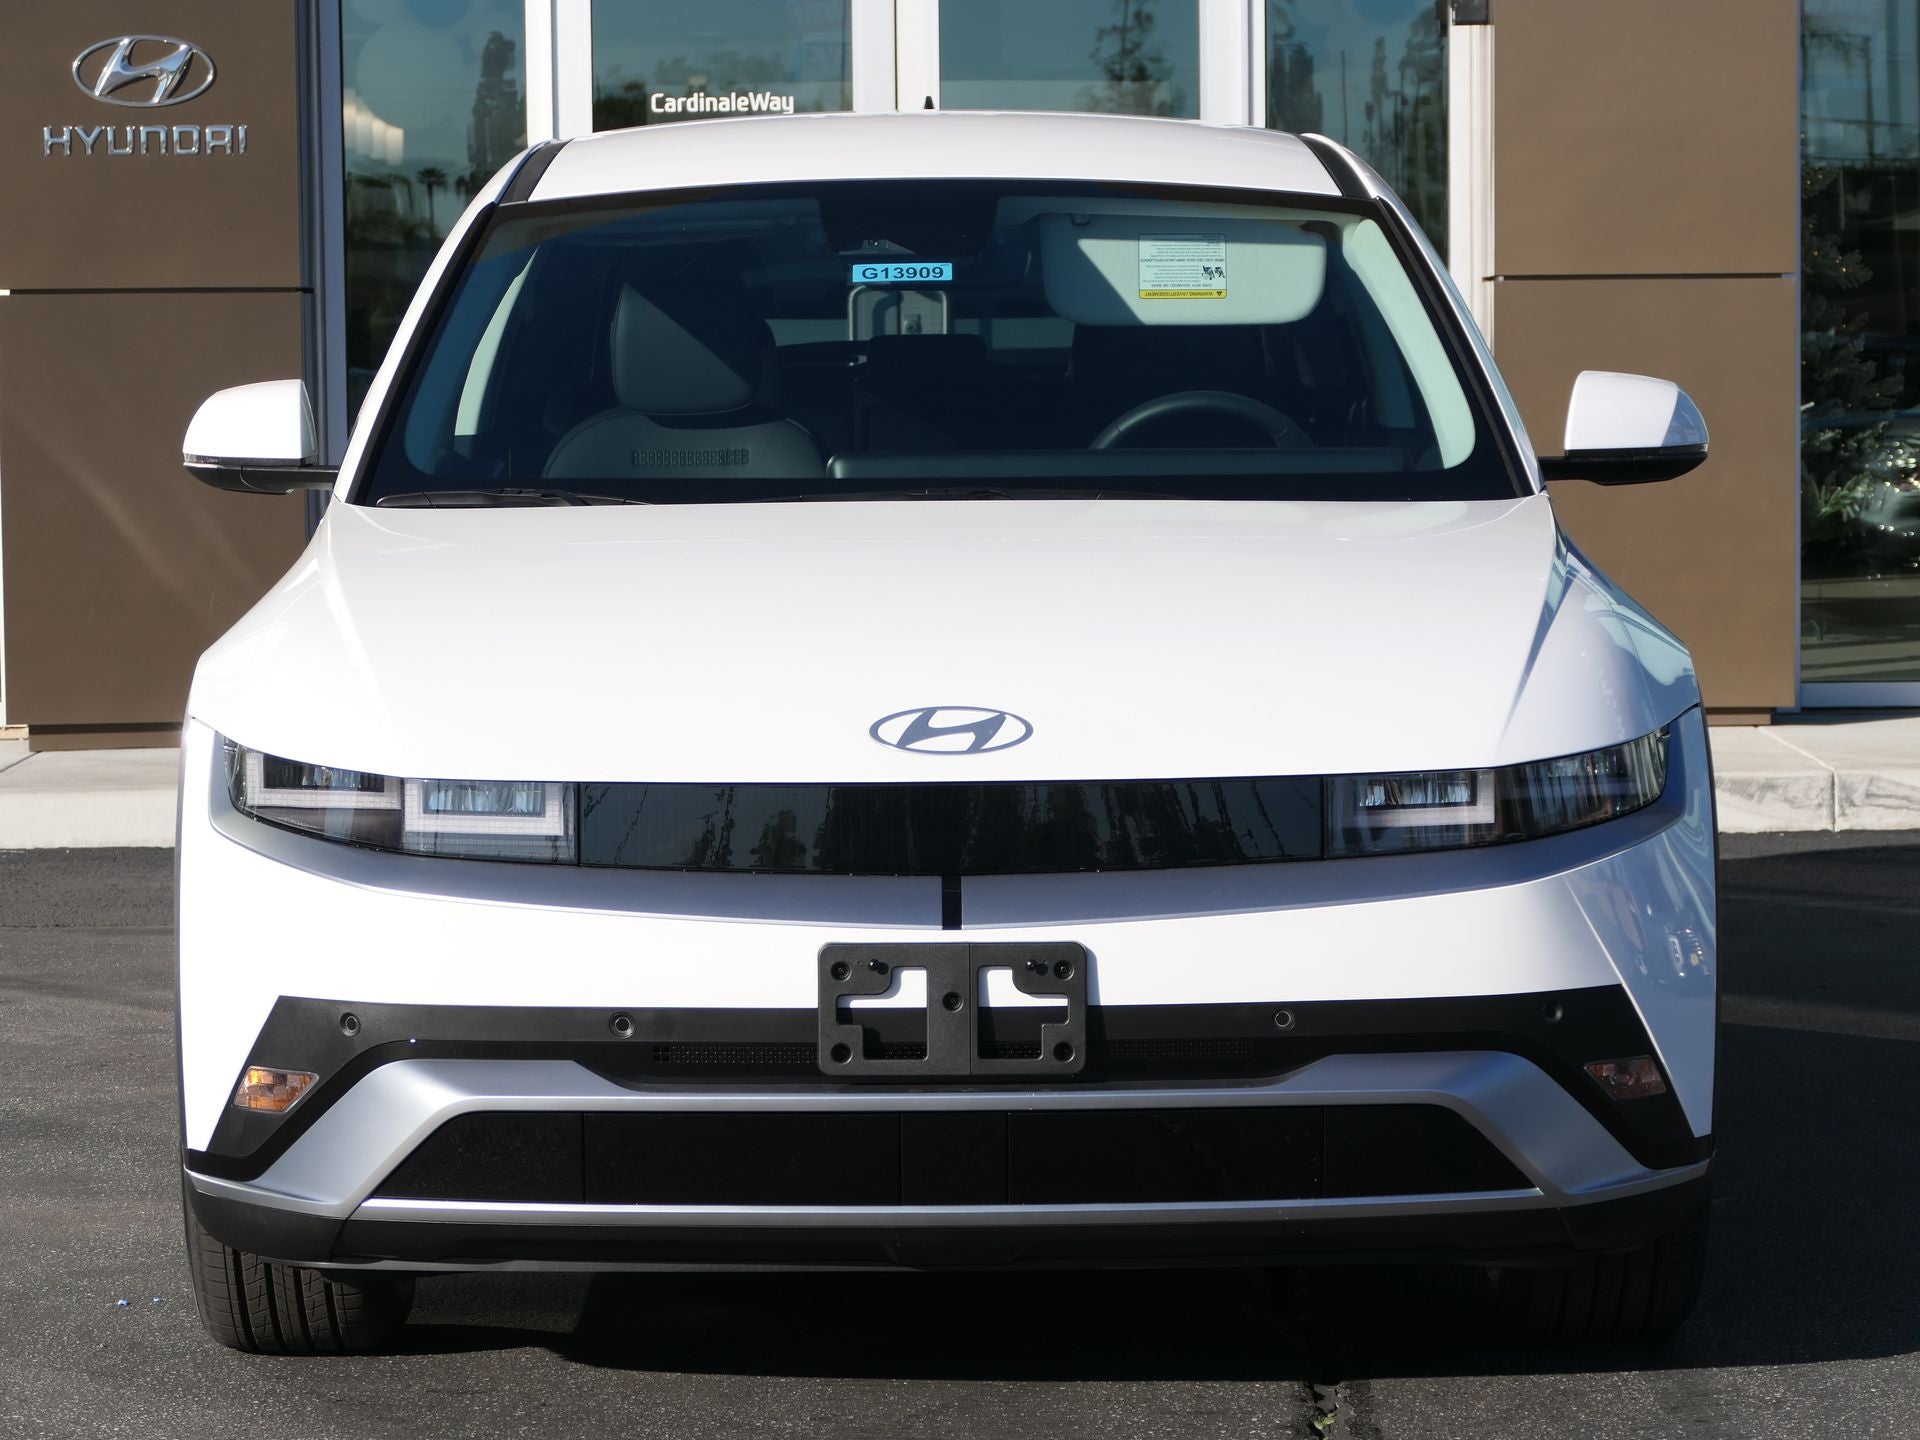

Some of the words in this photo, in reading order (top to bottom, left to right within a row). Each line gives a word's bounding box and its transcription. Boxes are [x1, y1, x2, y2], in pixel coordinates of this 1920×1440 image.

[650, 91, 794, 114] CardinaleWay
[42, 125, 248, 156] HYUNDAI
[861, 266, 944, 280] G13909
